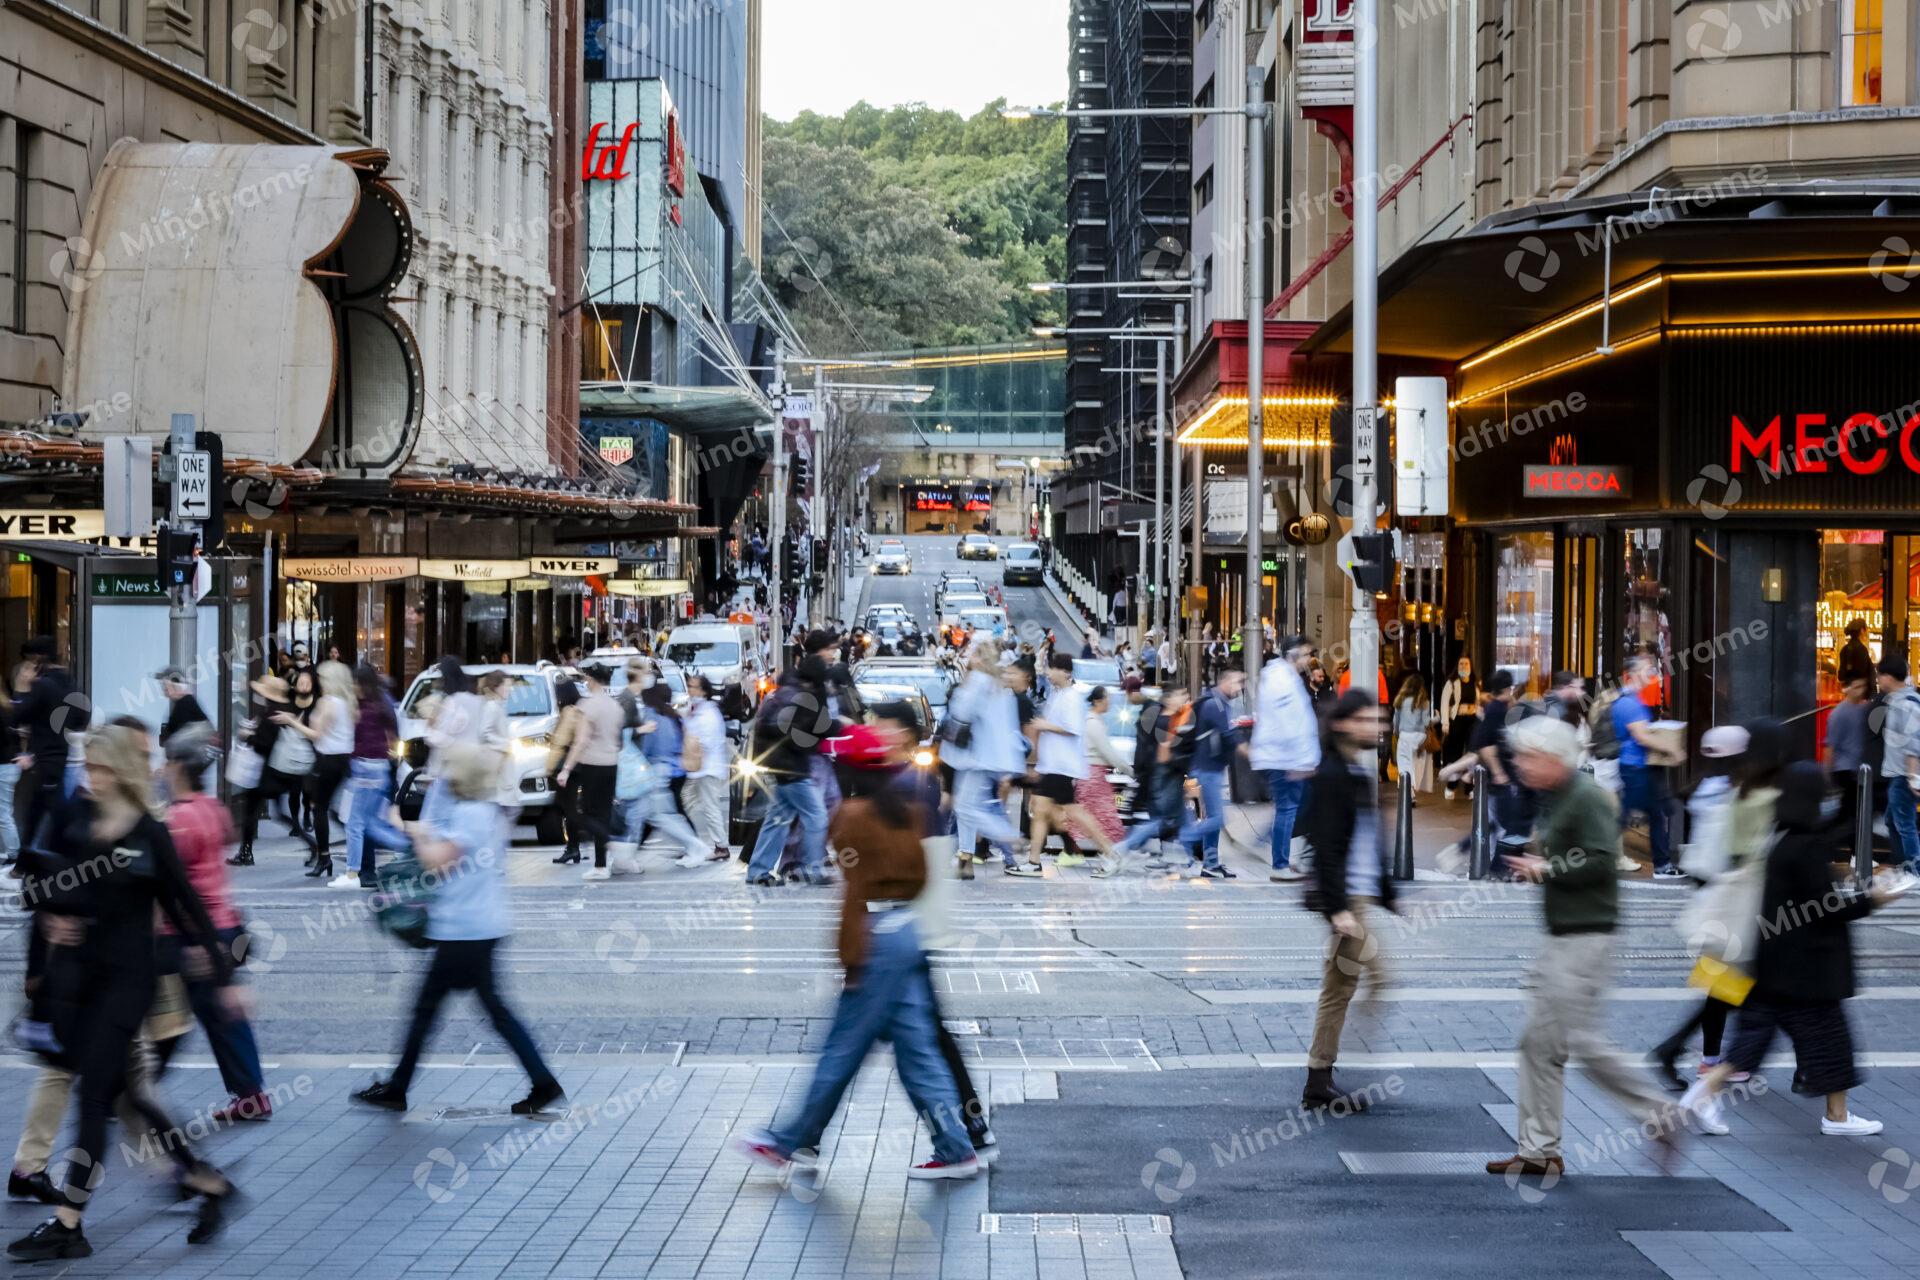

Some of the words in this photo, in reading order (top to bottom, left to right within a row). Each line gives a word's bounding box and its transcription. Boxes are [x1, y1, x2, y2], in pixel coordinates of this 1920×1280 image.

[1358, 414, 1371, 429] ONE
[603, 439, 630, 449] TAG
[1357, 435, 1372, 450] WAY
[602, 449, 631, 461] HEUER
[182, 458, 205, 472] ONE
[181, 478, 206, 493] WAY
[1528, 471, 1620, 491] MECCA
[353, 564, 405, 576] SYDNEY
[540, 560, 600, 571] MYER
[115, 579, 149, 593] News
